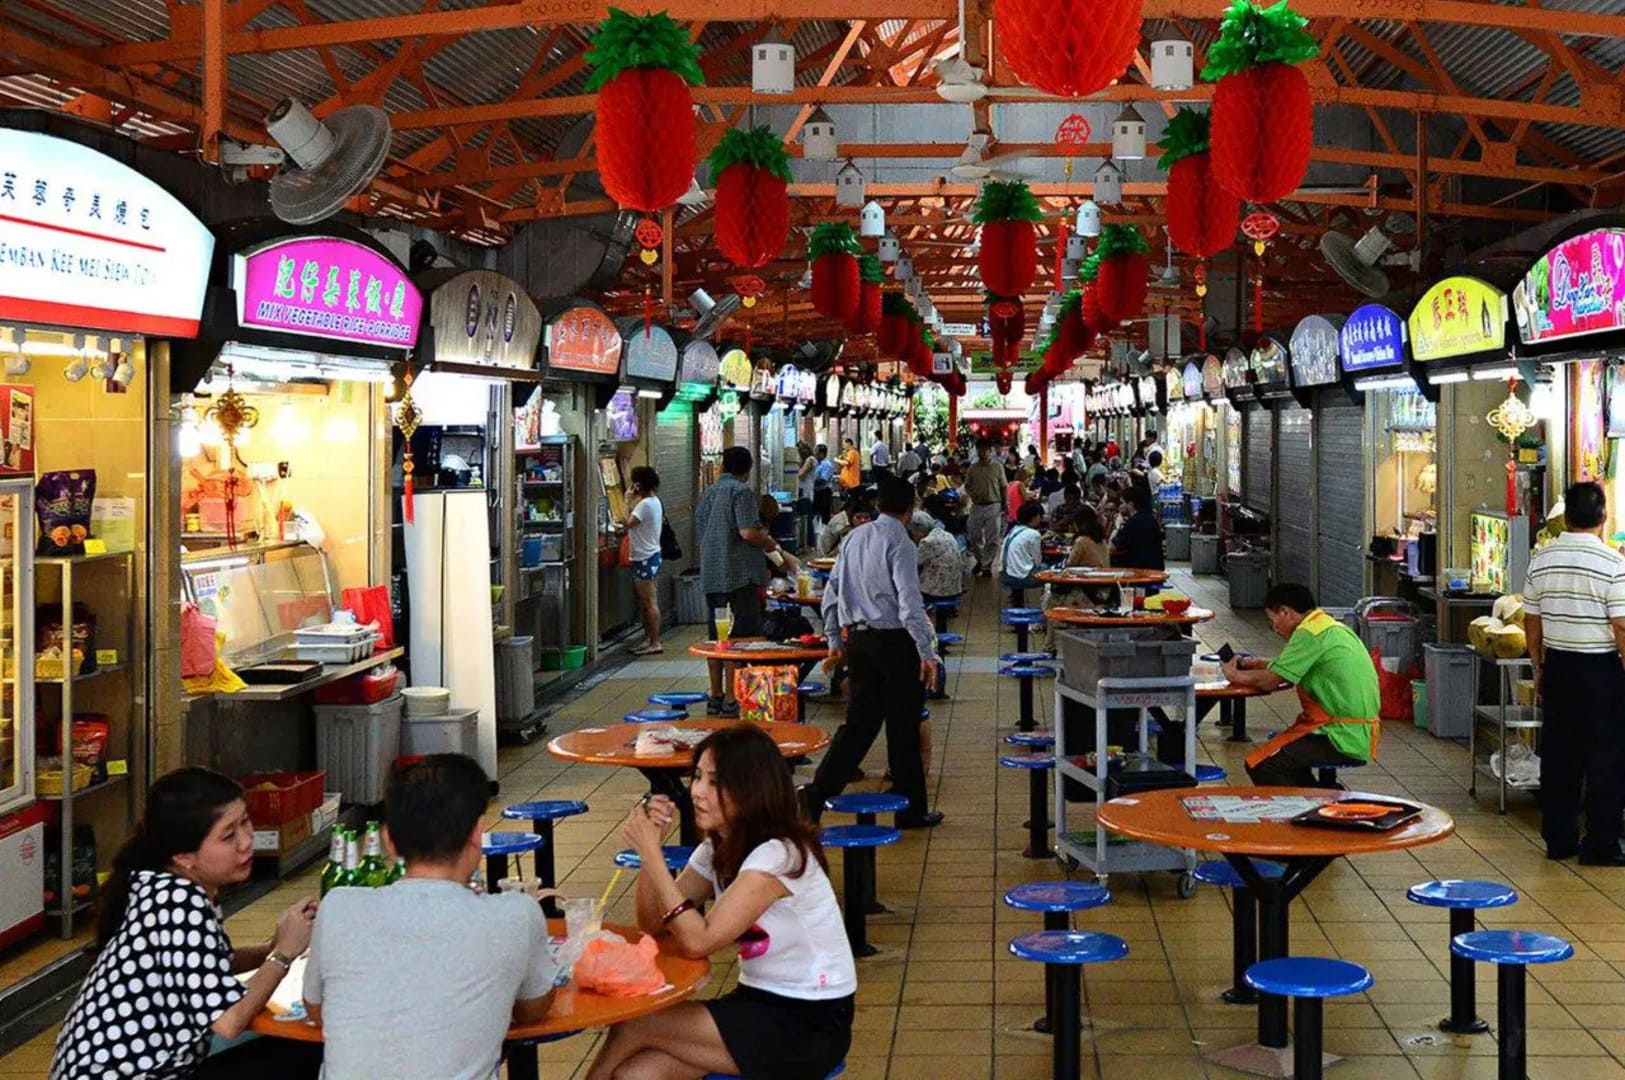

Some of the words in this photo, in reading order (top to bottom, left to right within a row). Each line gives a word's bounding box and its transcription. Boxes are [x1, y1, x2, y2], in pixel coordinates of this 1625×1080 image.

[51, 249, 74, 274] KEE
[256, 301, 282, 321] MIX
[283, 305, 341, 330] VEGETABLE
[343, 315, 365, 334] RICE
[367, 320, 411, 340] PORRIDGE
